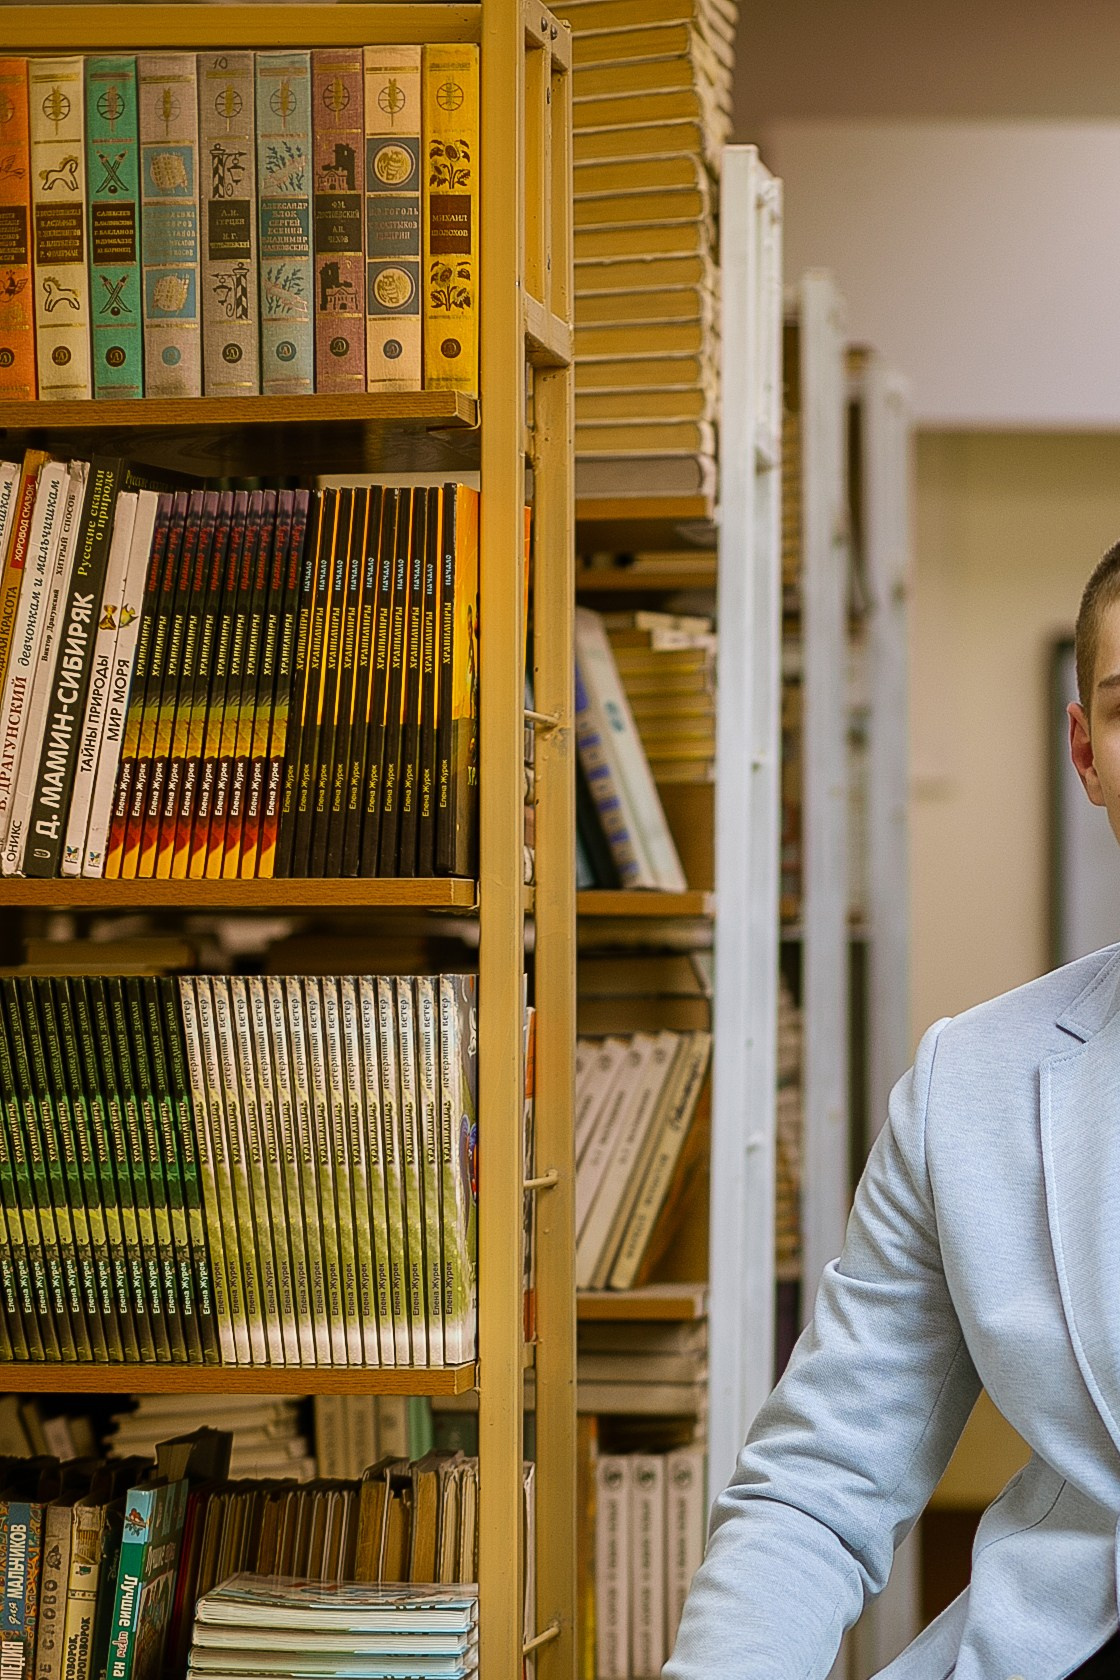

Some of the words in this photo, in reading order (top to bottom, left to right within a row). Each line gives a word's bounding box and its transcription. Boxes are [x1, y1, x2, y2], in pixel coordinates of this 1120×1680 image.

[213, 57, 227, 69] 10
[100, 471, 114, 523] природе
[14, 520, 29, 562] ХОРОВОД
[22, 483, 36, 518] СКАЗОК
[37, 480, 60, 575] мальчишкам
[56, 537, 69, 575] ХИТРЫЙ
[64, 495, 76, 532] СПОСОБ
[78, 521, 96, 576] Русские
[92, 470, 105, 518] сказки
[34, 578, 43, 587] и
[18, 592, 41, 666] девчонкам
[40, 592, 95, 809] МАМИН-СИБИРЯК
[88, 655, 109, 723] ПРИРОДЫ
[114, 659, 130, 704] МОРЯ
[0, 677, 27, 792] ДРАГУНСКИЙ
[107, 707, 122, 742] МИР
[80, 727, 98, 773] ТАЙНЫ
[120, 763, 131, 790] Журек
[185, 762, 196, 790] Журек
[251, 762, 262, 790] Журек
[116, 791, 127, 817] Елена
[182, 790, 192, 816] Елена
[248, 790, 259, 817] Елена
[7, 820, 22, 862] ОНИКС
[36, 814, 61, 839] Д.
[7, 1524, 27, 1599] МАЛЬЧИКОВ
[9, 1602, 18, 1624] для
[42, 1579, 58, 1650] СЛОВО
[119, 1574, 138, 1627] Лучшие
[112, 1661, 125, 1677] на
